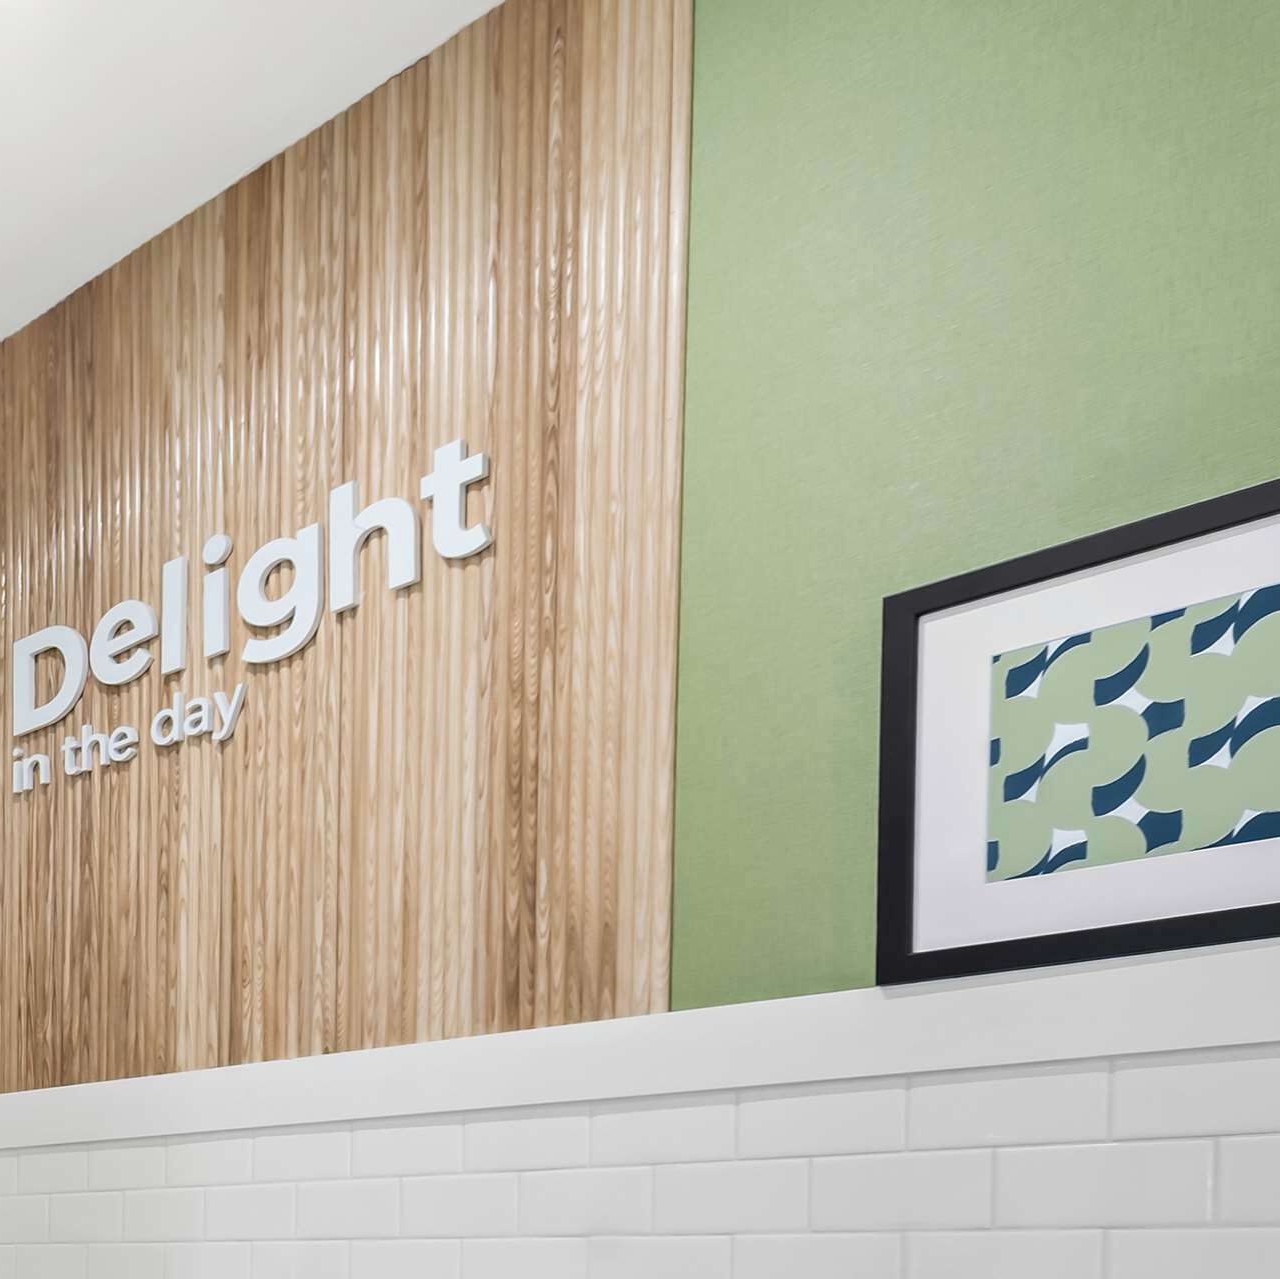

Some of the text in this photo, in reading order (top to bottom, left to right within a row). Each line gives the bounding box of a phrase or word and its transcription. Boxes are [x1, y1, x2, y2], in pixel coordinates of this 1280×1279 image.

[13, 439, 494, 737] Delight
[13, 682, 248, 793] in the day
